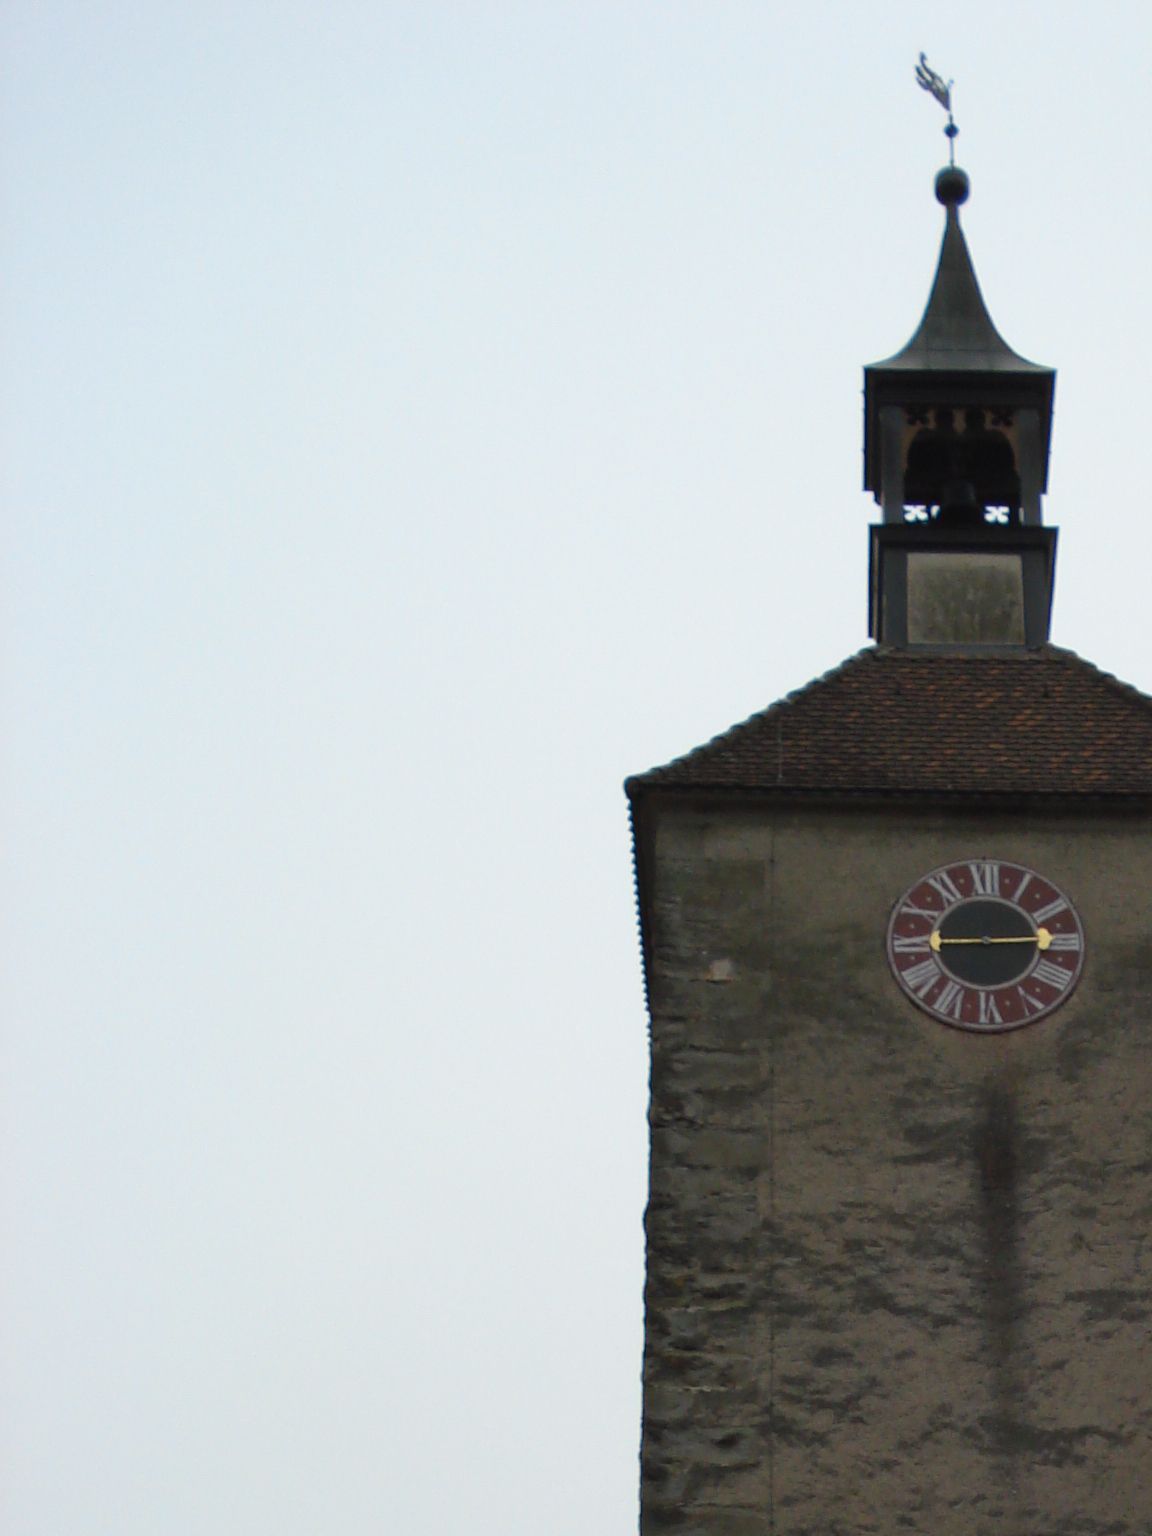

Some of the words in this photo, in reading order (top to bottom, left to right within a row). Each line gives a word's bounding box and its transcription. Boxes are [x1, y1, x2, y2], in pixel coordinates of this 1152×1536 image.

[926, 871, 963, 907] XI
[970, 864, 1000, 896] XII
[1012, 873, 1033, 903] I
[900, 899, 941, 923] X
[1032, 897, 1068, 924] II
[893, 934, 930, 953] IX
[1046, 933, 1079, 951] III
[901, 958, 940, 999] VIII
[932, 980, 965, 1019] VII
[979, 991, 1003, 1024] VI
[1017, 985, 1045, 1016] V
